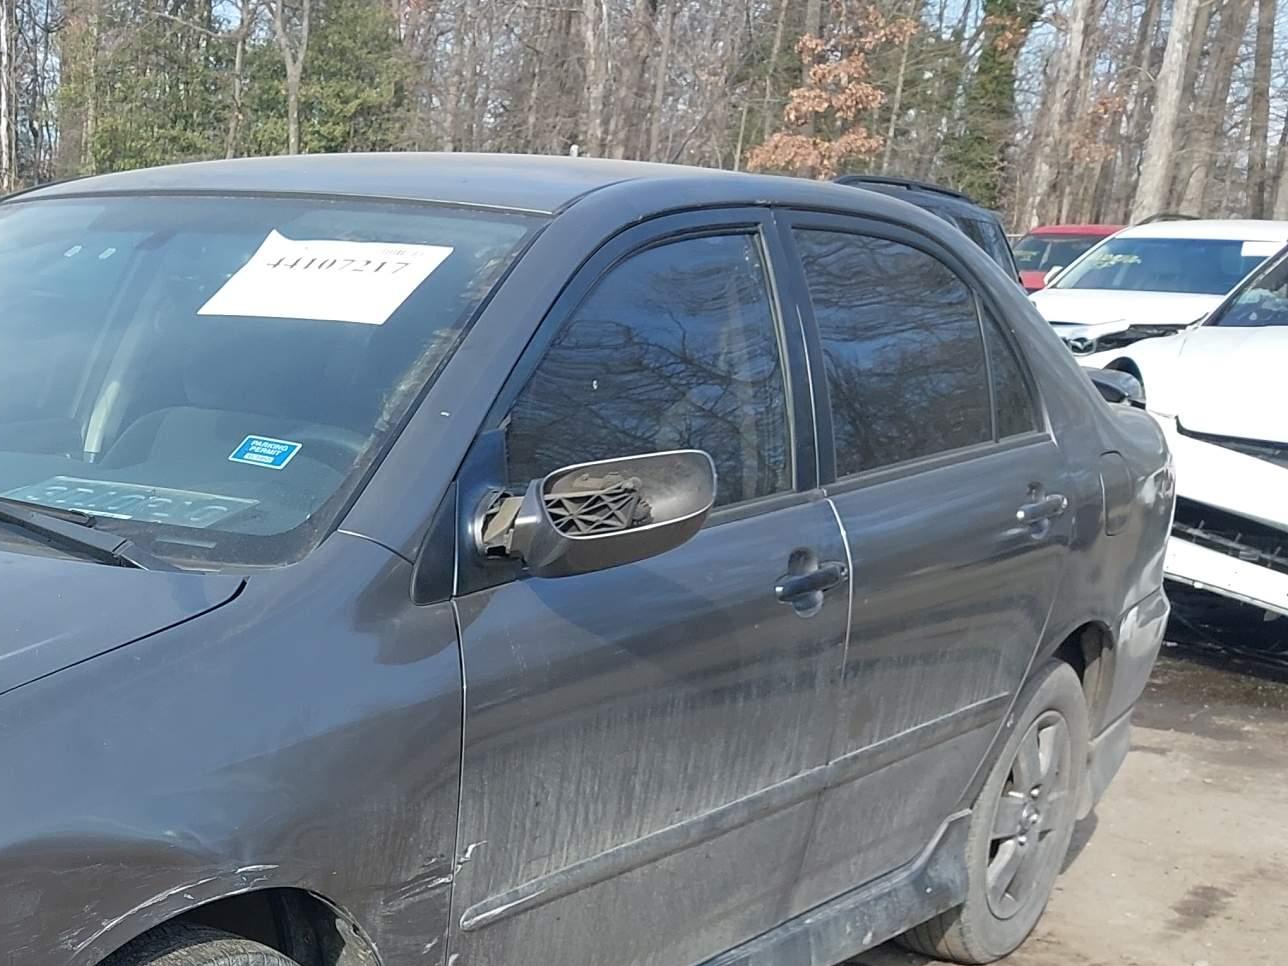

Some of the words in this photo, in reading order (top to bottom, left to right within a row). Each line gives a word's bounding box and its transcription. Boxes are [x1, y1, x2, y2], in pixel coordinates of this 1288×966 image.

[266, 256, 411, 275] 44107217
[249, 446, 282, 456] PERMIT
[250, 440, 288, 451] PARKING
